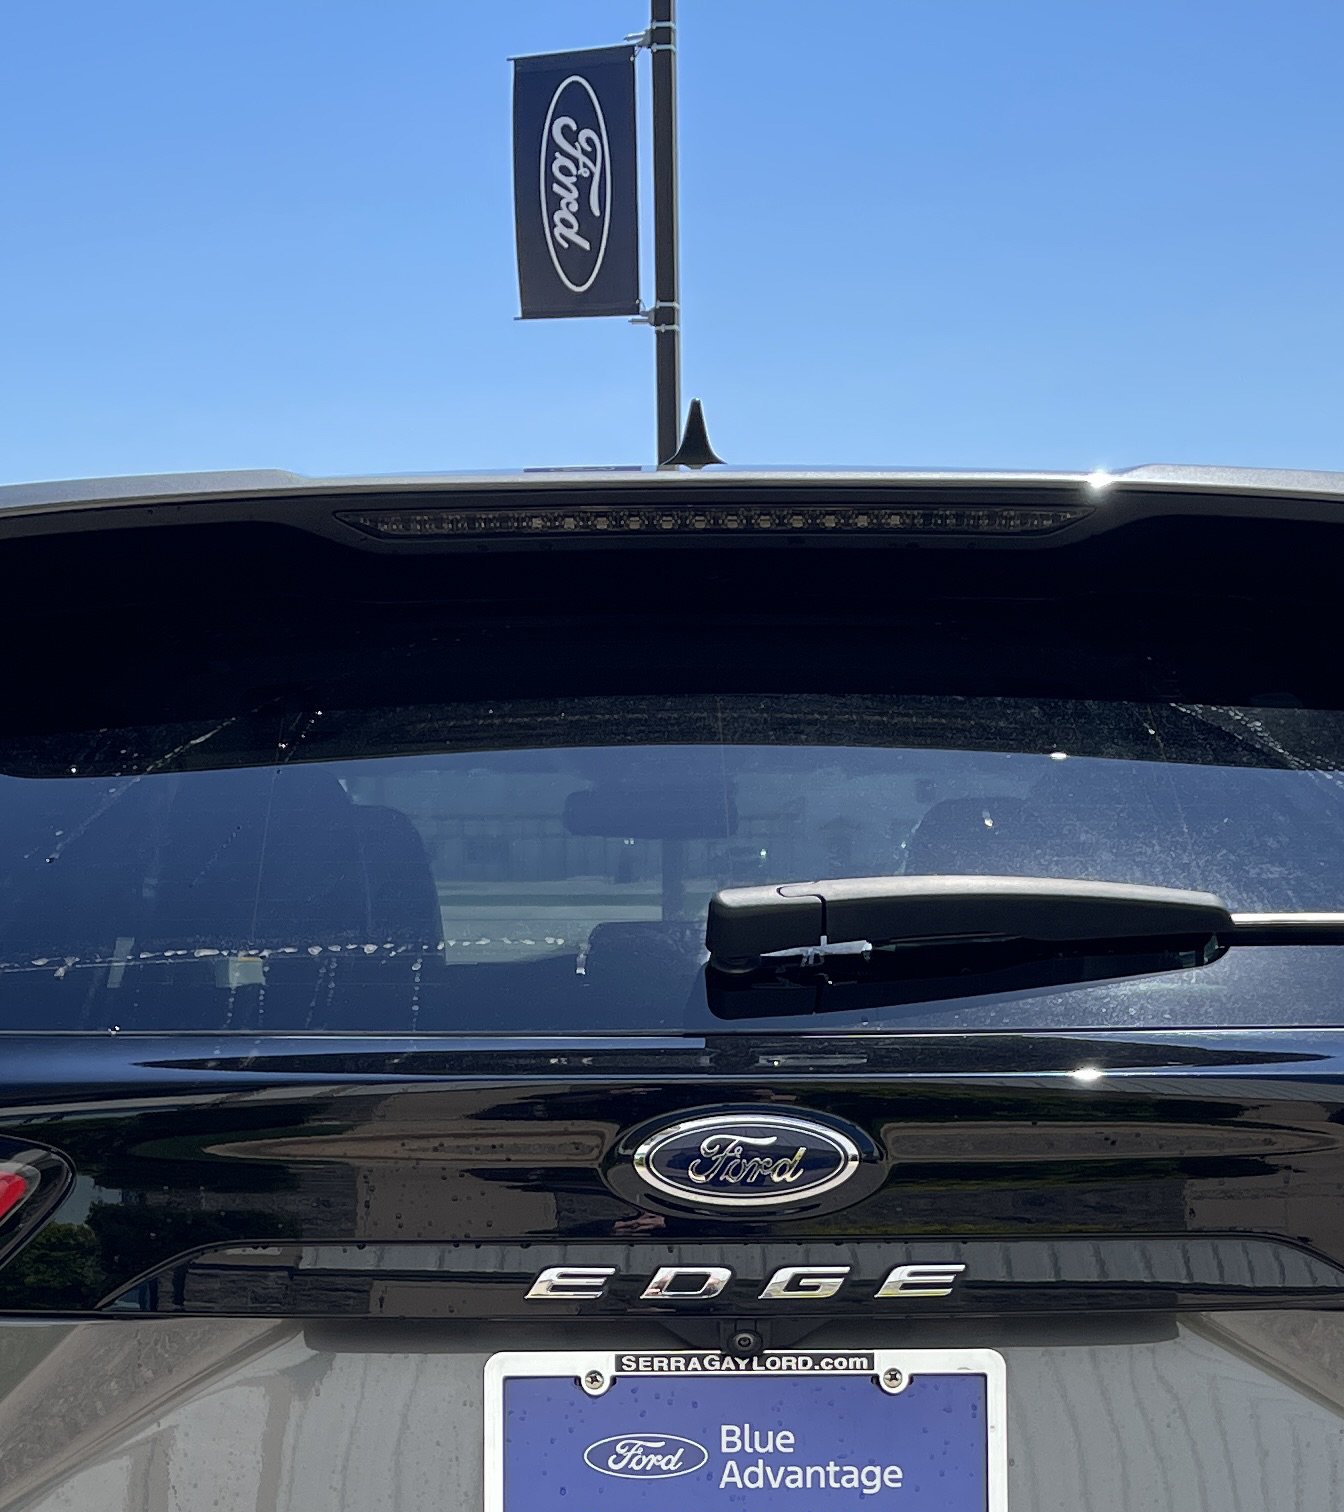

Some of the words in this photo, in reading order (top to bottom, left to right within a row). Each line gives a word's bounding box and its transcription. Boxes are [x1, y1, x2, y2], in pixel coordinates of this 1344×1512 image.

[552, 116, 603, 251] Ford
[688, 1133, 807, 1185] Ford
[523, 1263, 966, 1301] EDGE
[607, 1439, 685, 1472] Ford
[720, 1424, 796, 1454] Blue
[719, 1459, 904, 1495] Advantage
